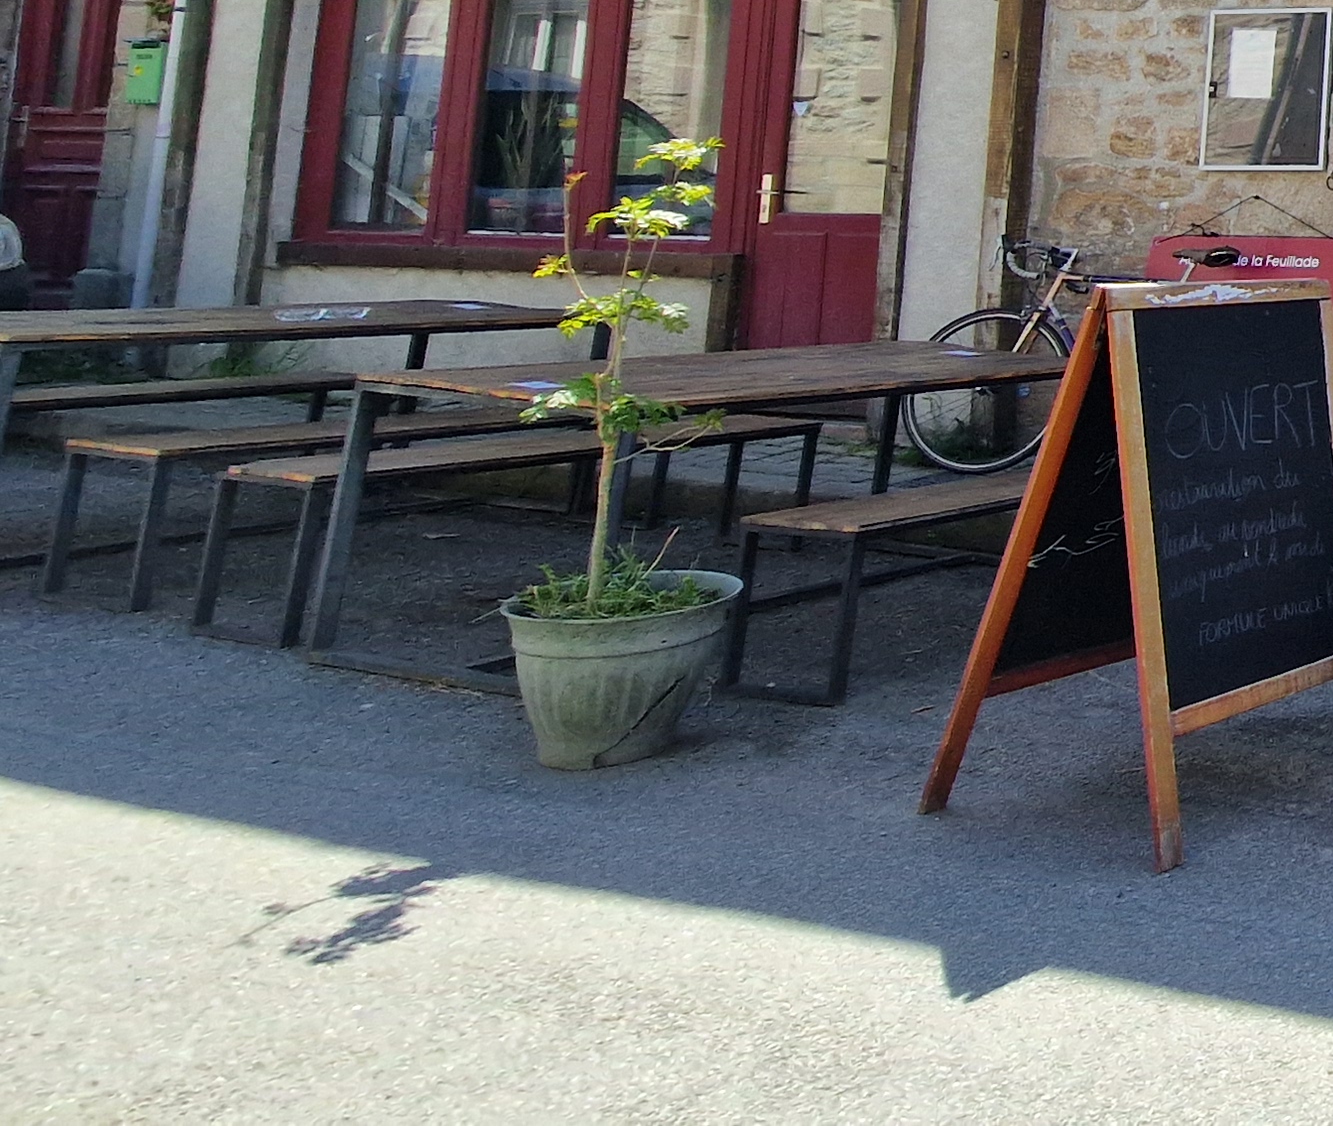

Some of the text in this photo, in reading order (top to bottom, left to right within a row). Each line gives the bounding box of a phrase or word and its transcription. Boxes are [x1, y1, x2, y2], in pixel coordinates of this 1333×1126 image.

[1251, 255, 1263, 267] la
[1266, 254, 1320, 268] Feuillade
[1165, 379, 1319, 459] OUVERT
